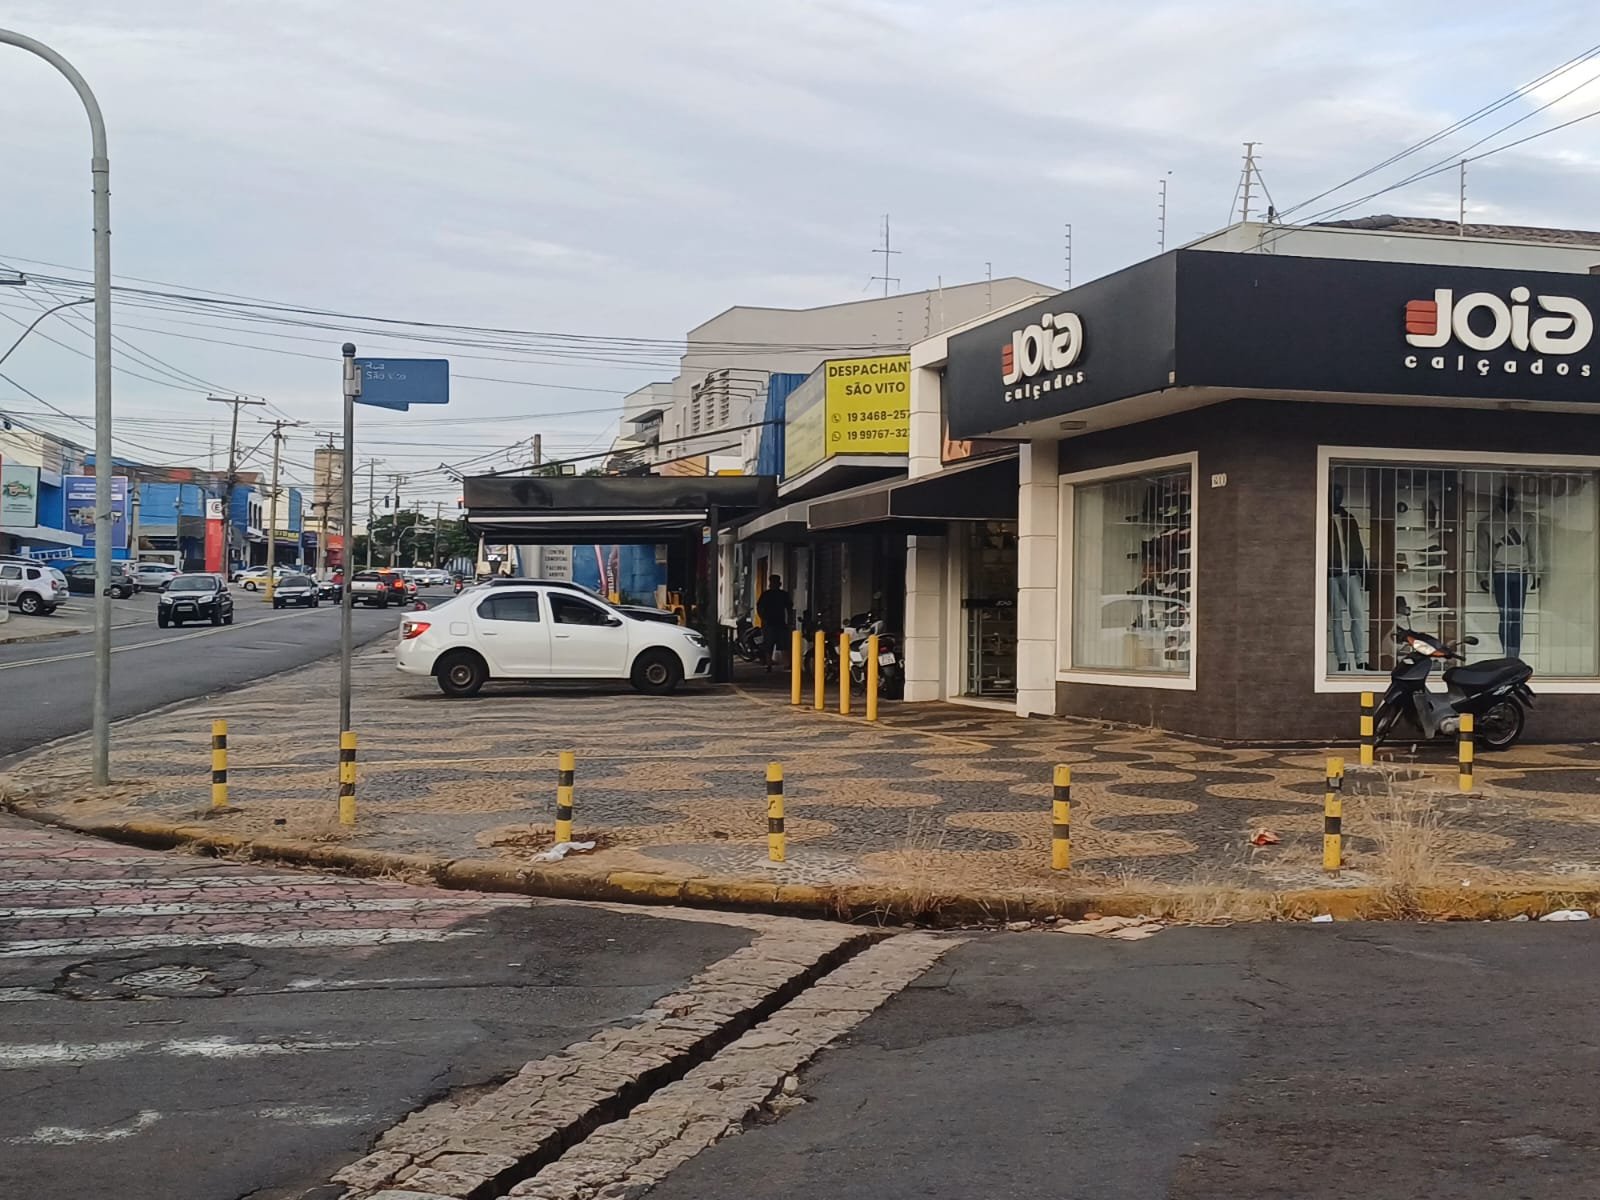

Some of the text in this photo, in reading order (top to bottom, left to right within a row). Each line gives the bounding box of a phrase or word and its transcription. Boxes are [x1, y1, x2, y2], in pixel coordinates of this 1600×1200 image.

[1404, 354, 1591, 378] calçados
[845, 381, 906, 396] SÃO VITO
[1004, 371, 1084, 403] calçados
[847, 412, 857, 423] 19
[847, 431, 857, 441] 19
